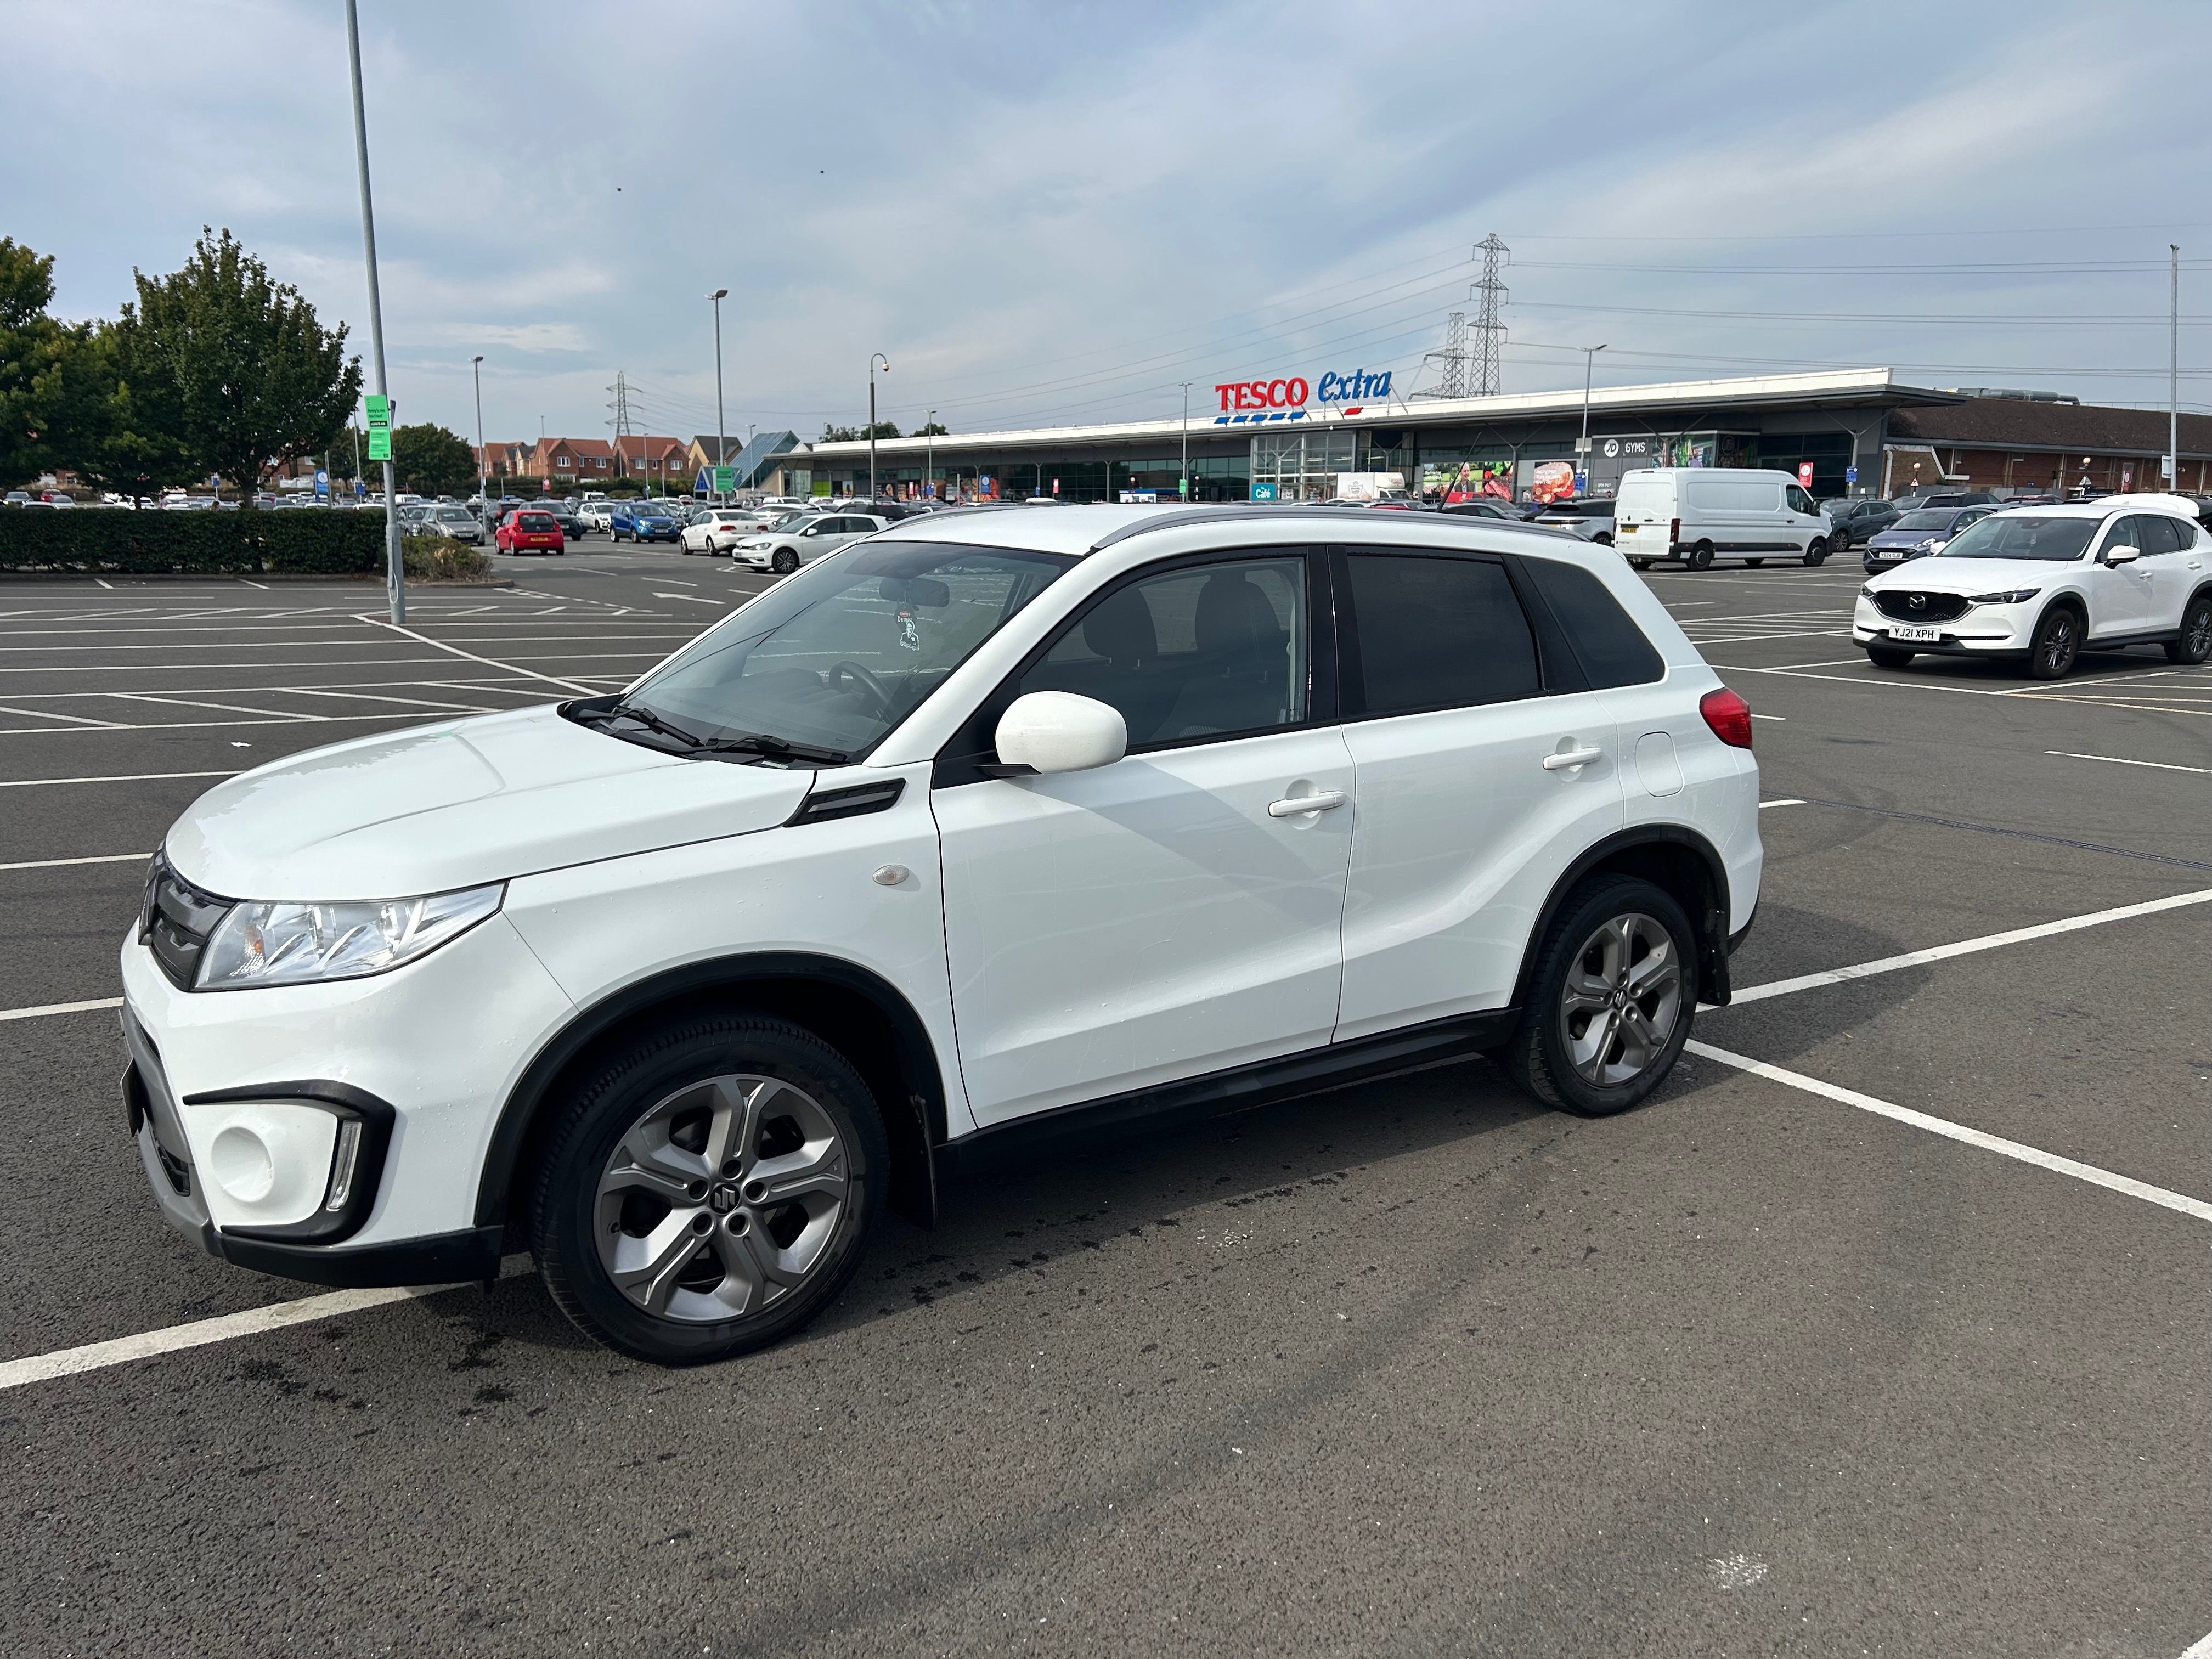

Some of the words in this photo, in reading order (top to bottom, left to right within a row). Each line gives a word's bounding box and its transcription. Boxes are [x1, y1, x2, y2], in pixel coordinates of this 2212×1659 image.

[1215, 377, 1308, 410] TESCO
[1318, 369, 1392, 402] extra
[1606, 443, 1617, 453] JD
[1626, 442, 1645, 453] GYMS
[1255, 488, 1271, 498] Café
[1894, 627, 1914, 637] YJ21
[1915, 629, 1934, 639] XPH
